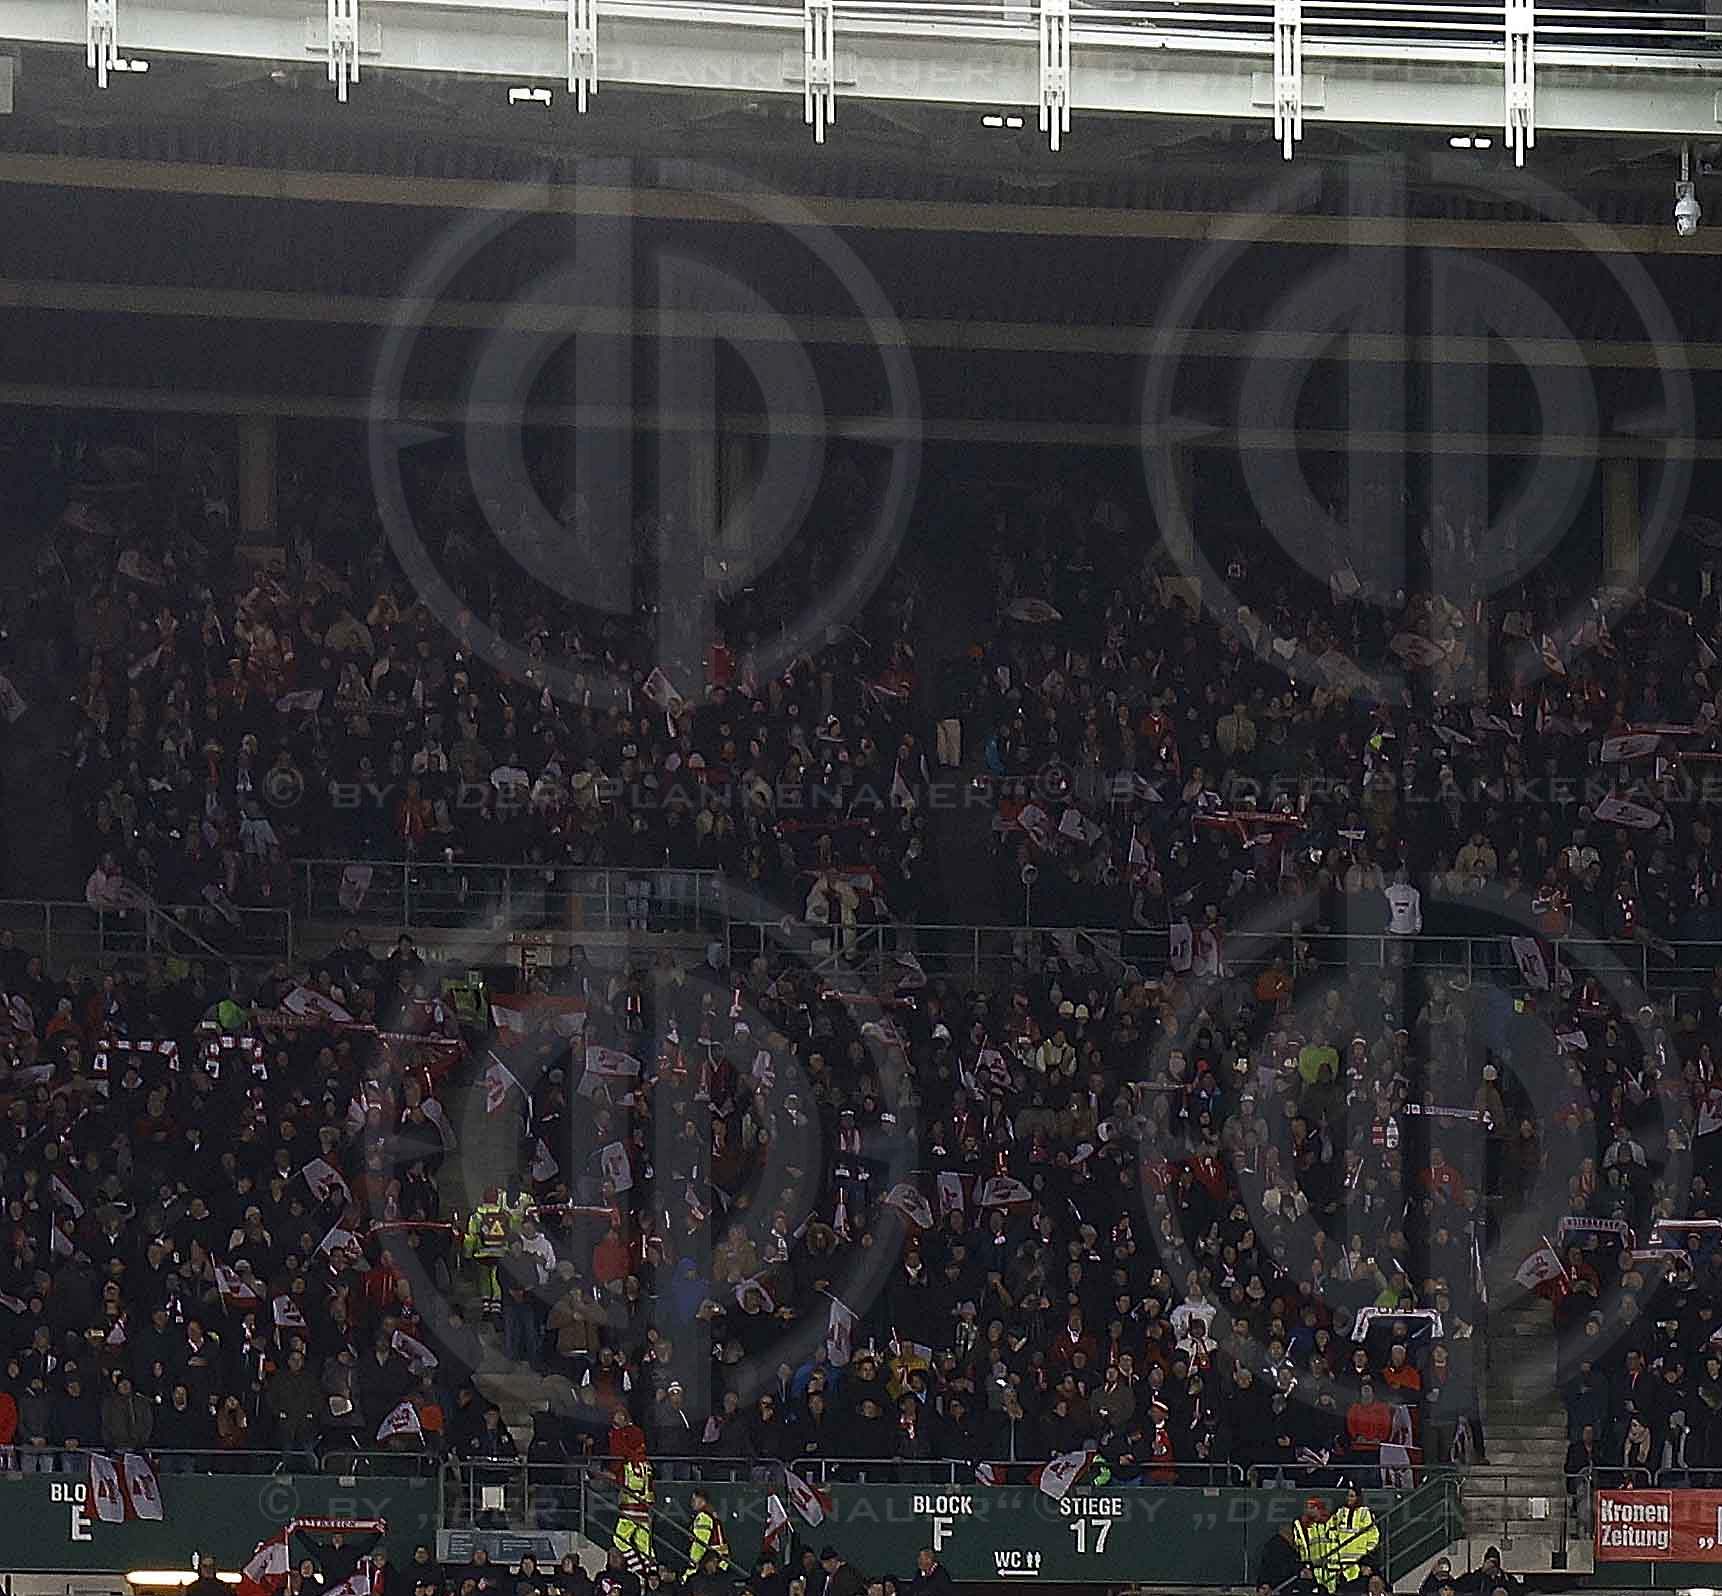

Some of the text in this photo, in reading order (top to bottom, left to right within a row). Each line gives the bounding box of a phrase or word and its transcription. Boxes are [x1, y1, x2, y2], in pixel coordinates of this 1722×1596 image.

[914, 1497, 972, 1514] BLOCK
[1060, 1497, 1122, 1515] STIEGE
[1601, 1500, 1669, 1523] Kronen
[71, 1505, 92, 1541] E
[933, 1518, 953, 1551] F
[1070, 1518, 1112, 1553] 17
[1600, 1524, 1670, 1550] Zeitung
[995, 1551, 1023, 1567] WC
